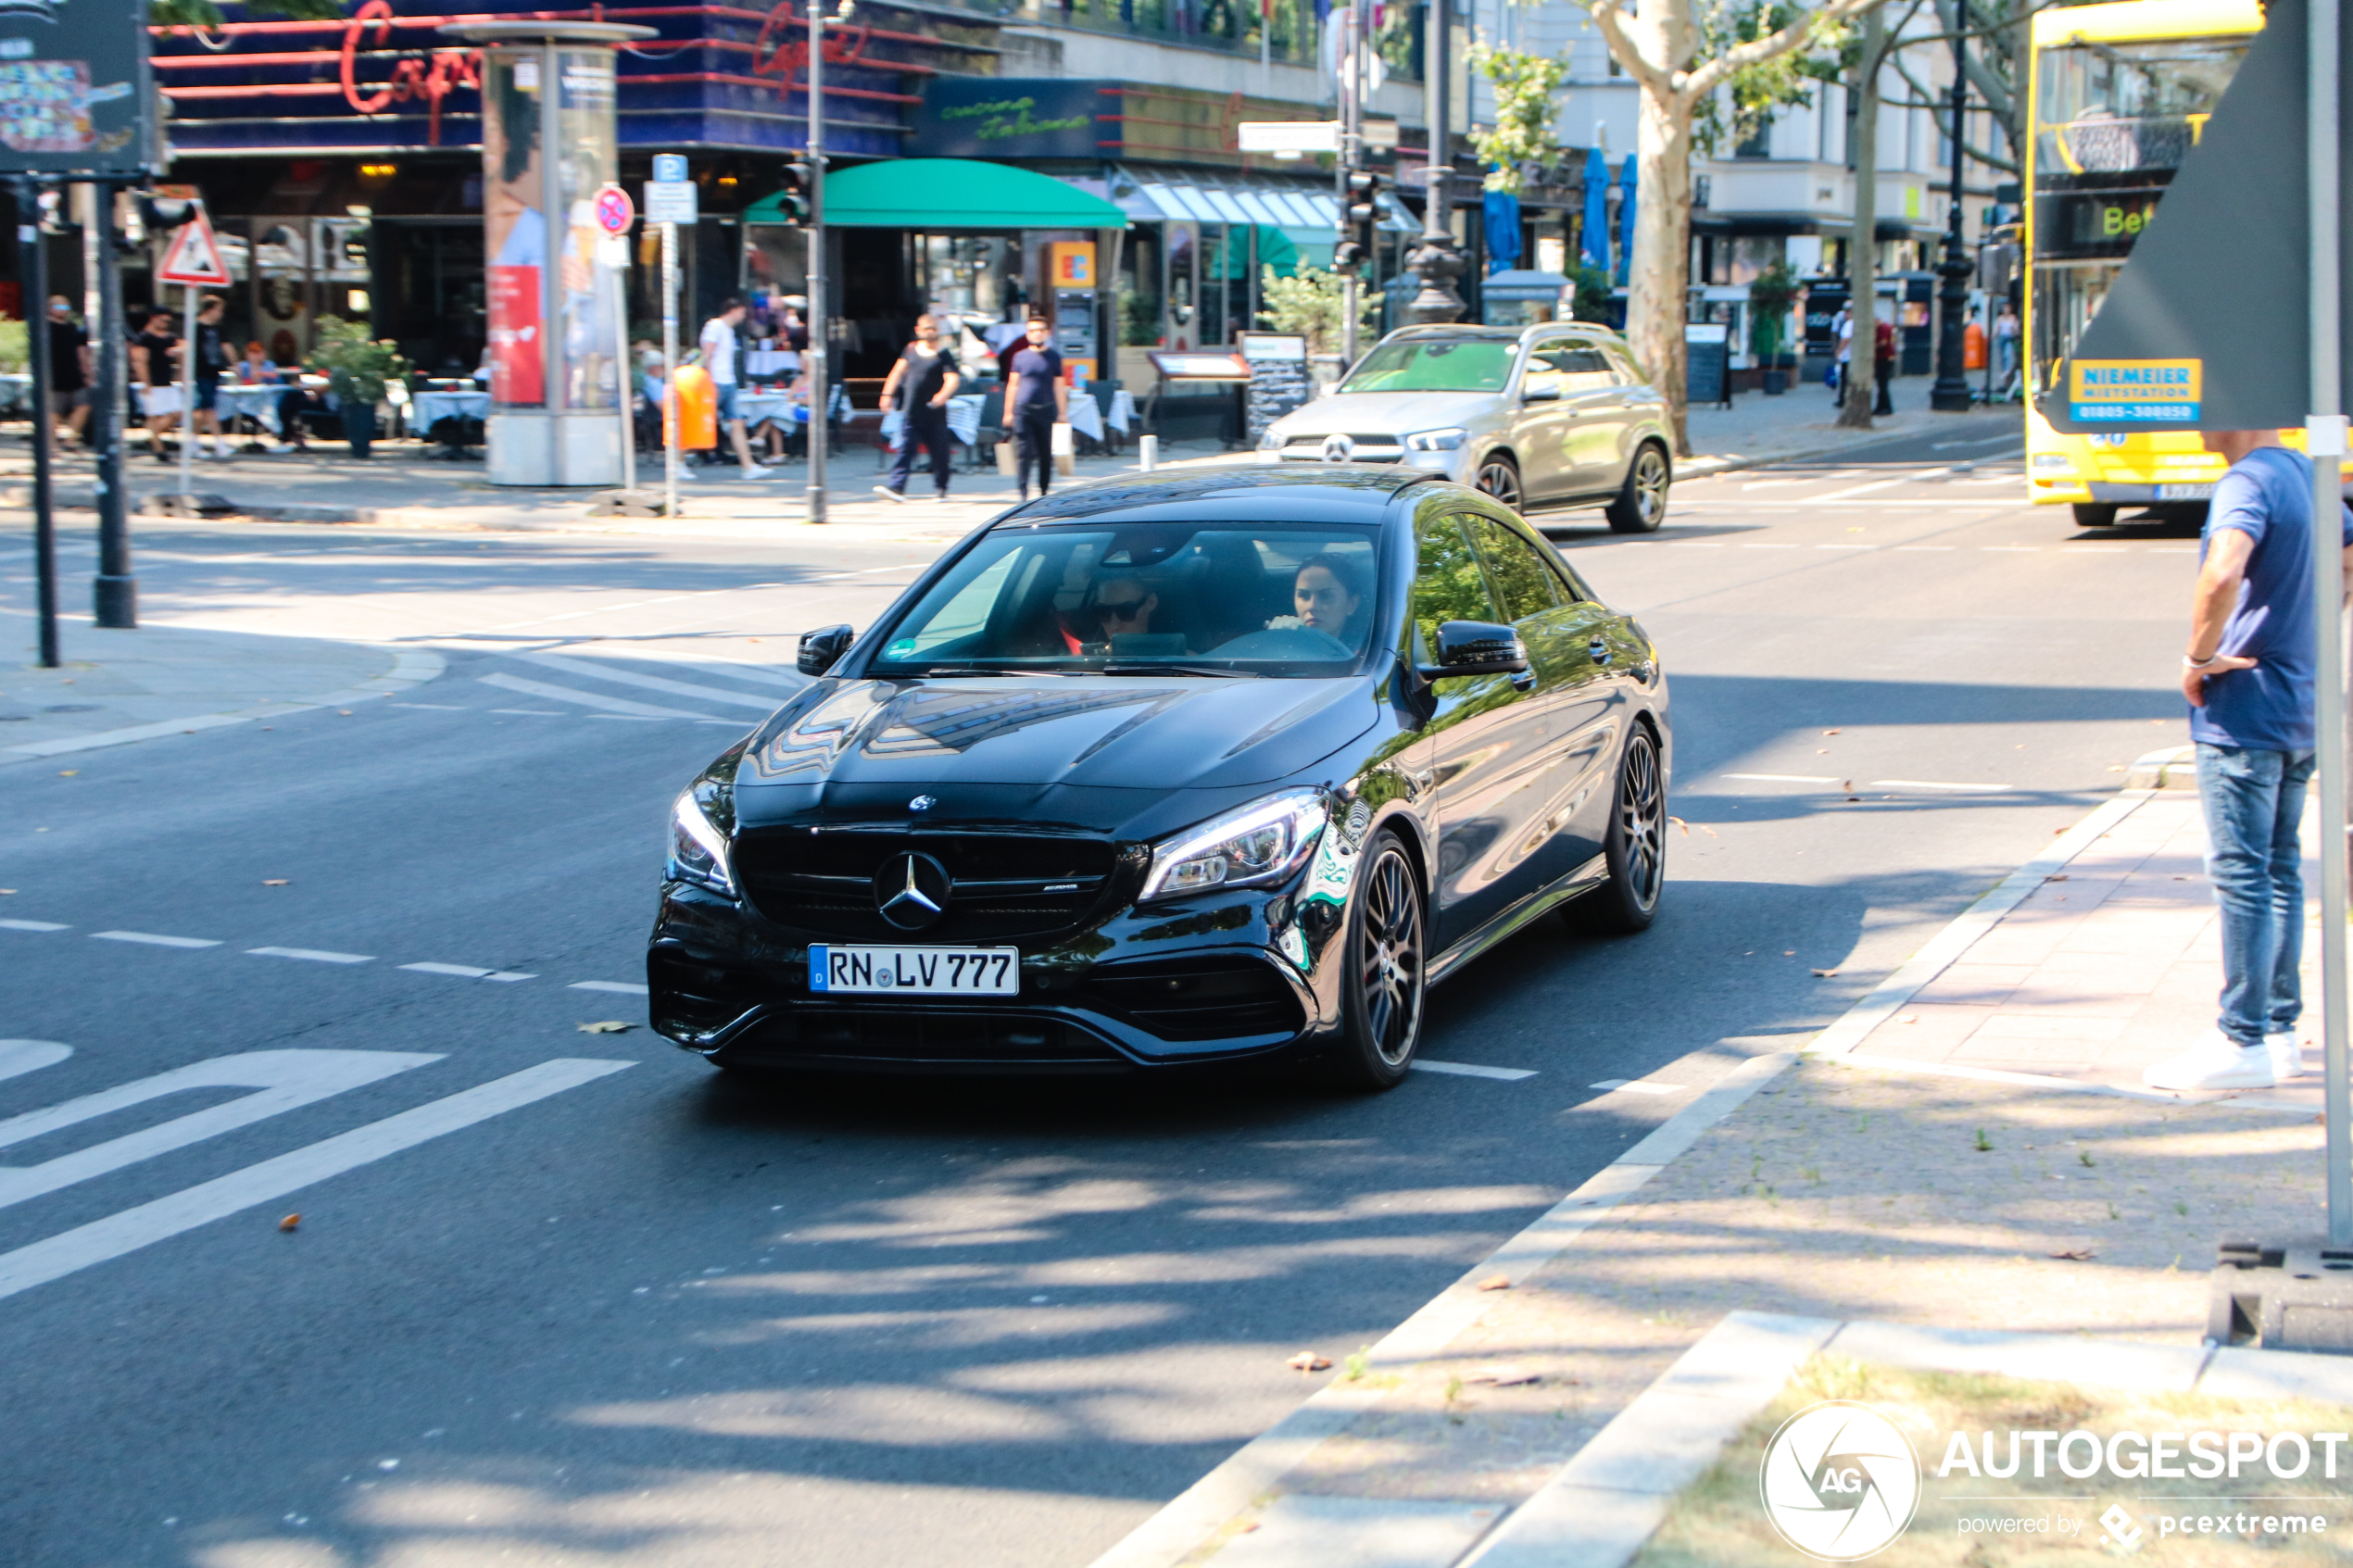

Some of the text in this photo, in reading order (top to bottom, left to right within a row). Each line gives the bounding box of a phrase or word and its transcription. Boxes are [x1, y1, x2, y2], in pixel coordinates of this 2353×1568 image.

[2083, 368, 2190, 384] NIEMEIER
[2083, 388, 2189, 397] MIETSTATION
[829, 952, 1011, 987] RN LV 777
[815, 973, 823, 983] D
